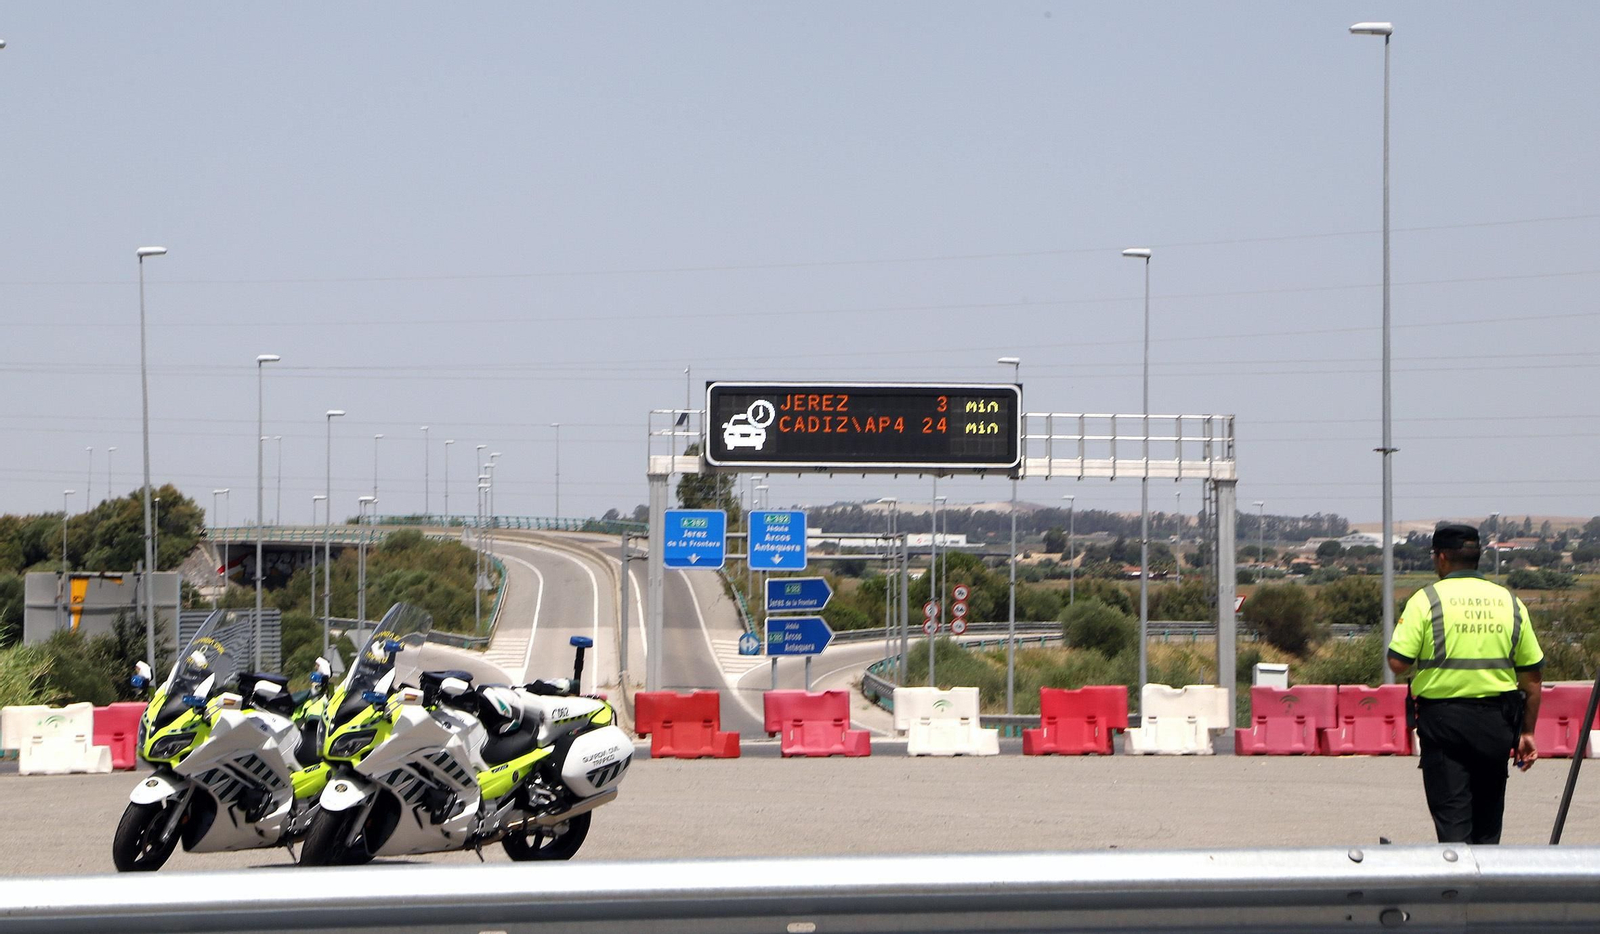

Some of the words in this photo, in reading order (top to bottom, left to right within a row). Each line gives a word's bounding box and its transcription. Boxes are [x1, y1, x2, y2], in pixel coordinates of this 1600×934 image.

[780, 394, 849, 412] JEREZ
[936, 394, 948, 412] 3
[965, 399, 999, 413] min
[922, 416, 948, 434] 24
[965, 420, 999, 434] min
[682, 529, 708, 538] Jerez
[764, 532, 791, 542] Arcos
[666, 540, 677, 548] de
[678, 539, 688, 548] la
[689, 539, 721, 548] Frontera
[753, 542, 802, 553] Antequera
[1449, 598, 1505, 608] GUARDIA
[1464, 610, 1494, 620] CIVIL
[1454, 623, 1504, 634] TRAFICO
